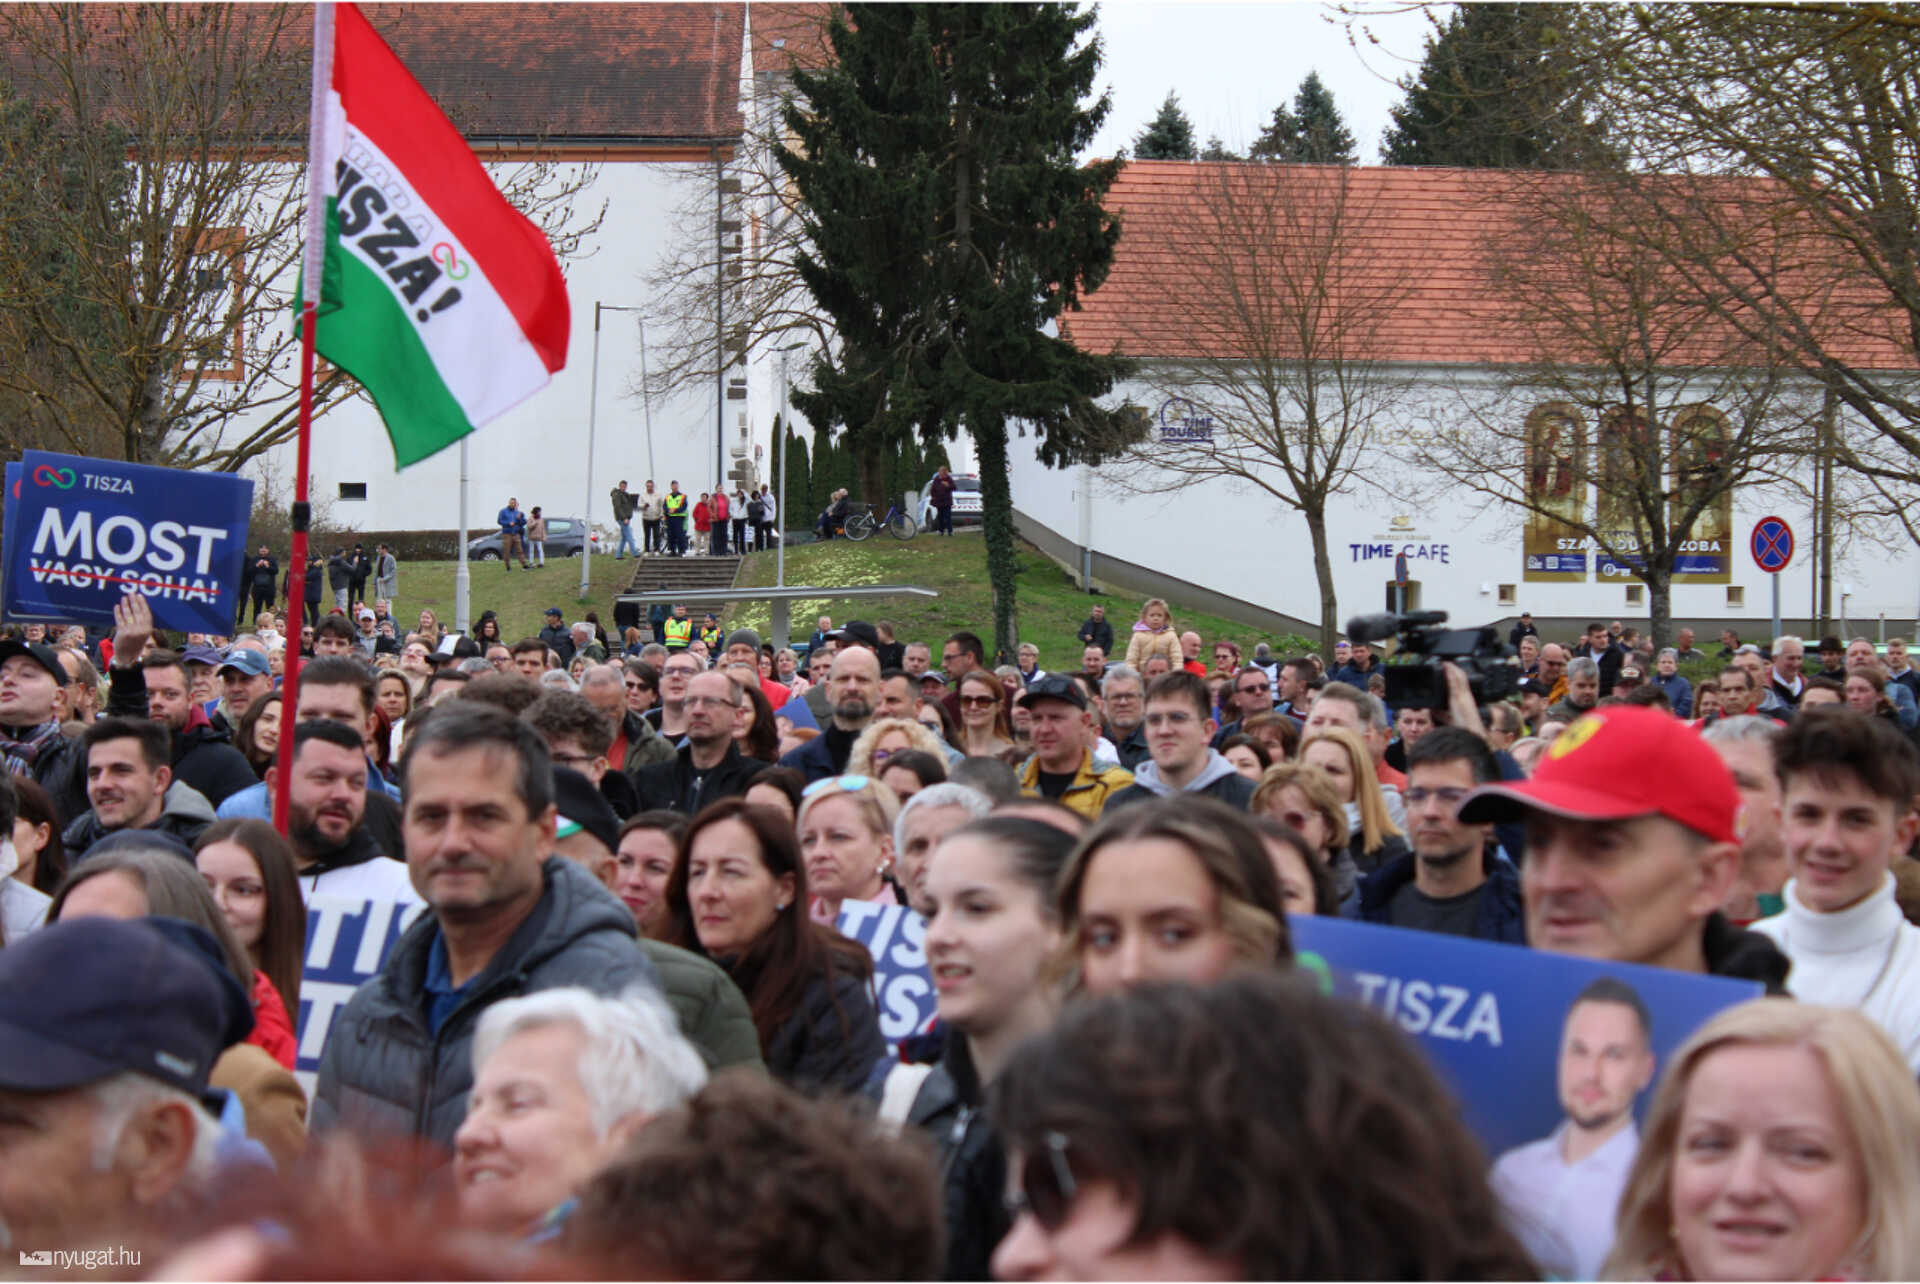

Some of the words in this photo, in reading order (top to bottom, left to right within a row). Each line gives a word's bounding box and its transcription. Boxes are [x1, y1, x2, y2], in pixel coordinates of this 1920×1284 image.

[1160, 427, 1213, 438] TOURIST
[1183, 417, 1213, 427] TIME
[83, 473, 134, 494] TISZA
[32, 507, 228, 575] MOST
[1349, 544, 1394, 562] TIME
[1402, 544, 1450, 564] CAFE
[30, 558, 114, 590] VAGY
[119, 569, 219, 604] SOHA!
[1353, 972, 1503, 1047] TISZA
